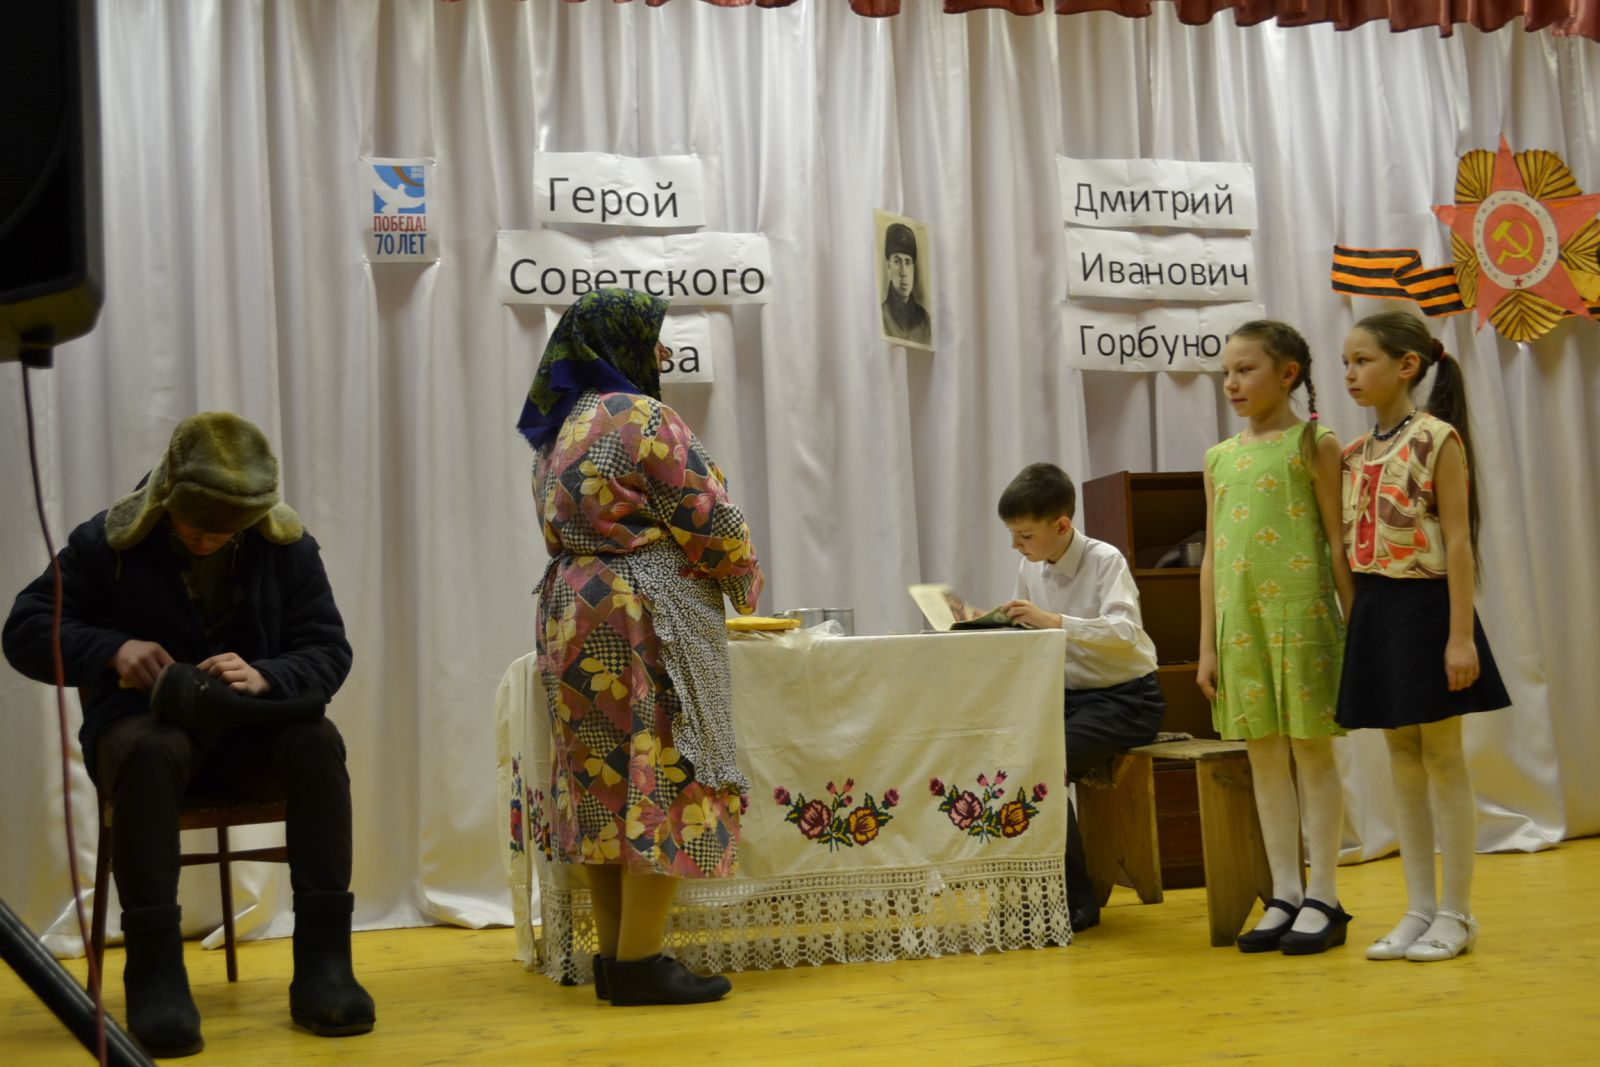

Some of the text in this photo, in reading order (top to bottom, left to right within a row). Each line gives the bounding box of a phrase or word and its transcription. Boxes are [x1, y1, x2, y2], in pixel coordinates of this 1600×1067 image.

[548, 177, 679, 223] Герой
[1074, 182, 1234, 221] Дмитрий
[373, 216, 427, 232] ПОБЕДА!
[374, 233, 427, 255] 70 ЛЕТ
[509, 258, 765, 297] Советского
[1081, 252, 1249, 287] Иванович
[1079, 325, 1230, 365] Горбуно
